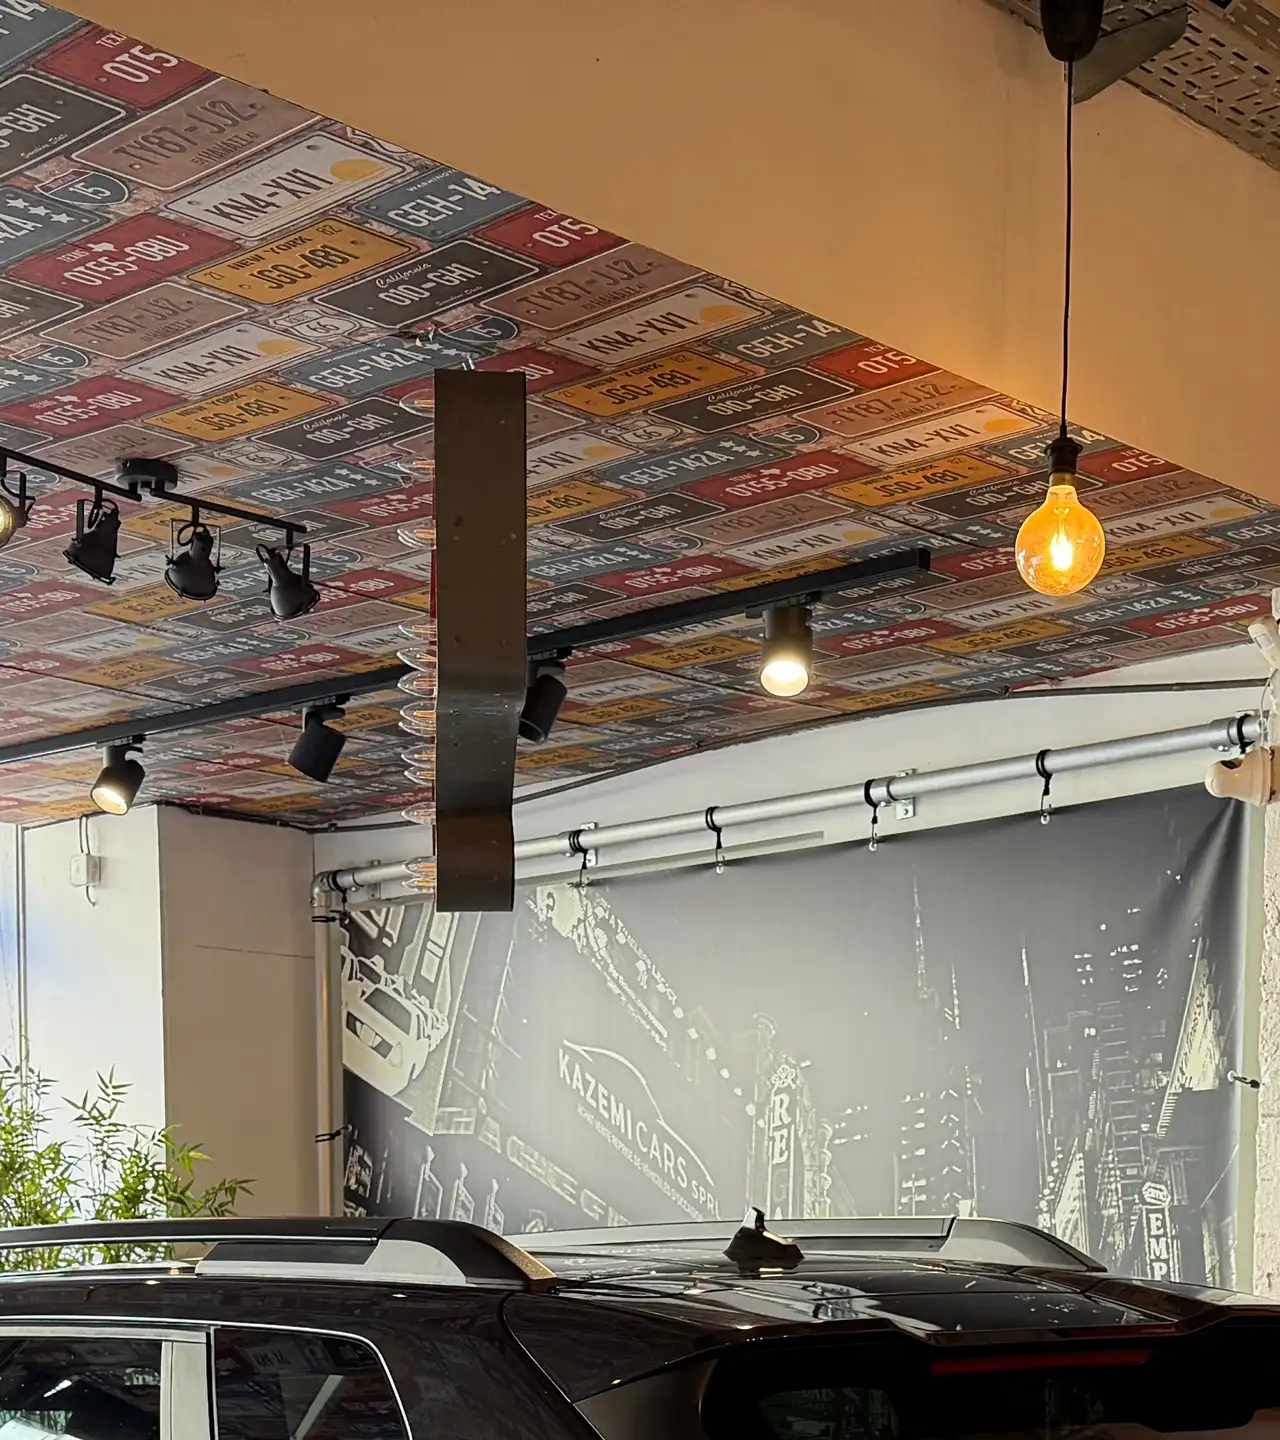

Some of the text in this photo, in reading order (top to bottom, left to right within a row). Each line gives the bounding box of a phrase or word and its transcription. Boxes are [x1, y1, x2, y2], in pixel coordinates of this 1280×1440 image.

[69, 182, 112, 200] 15
[227, 223, 343, 272] NEW YORK 82
[375, 262, 432, 289] California
[514, 258, 647, 311] TY87-JJ2
[308, 320, 340, 335] 66
[37, 352, 74, 368] 15
[309, 348, 431, 389] GEH-142A
[582, 363, 662, 390] NEW YORK
[176, 390, 246, 418] NEW YORK
[707, 384, 761, 401] California
[302, 412, 350, 432] California
[634, 428, 661, 442] 66
[775, 430, 804, 443] 15
[620, 450, 735, 486] GEH-142A
[860, 473, 895, 486] NEW
[252, 476, 358, 503] GEH-142A
[529, 550, 628, 579] GEH-142A
[558, 1048, 632, 1141] KAZEMI
[636, 1120, 688, 1189] CARS
